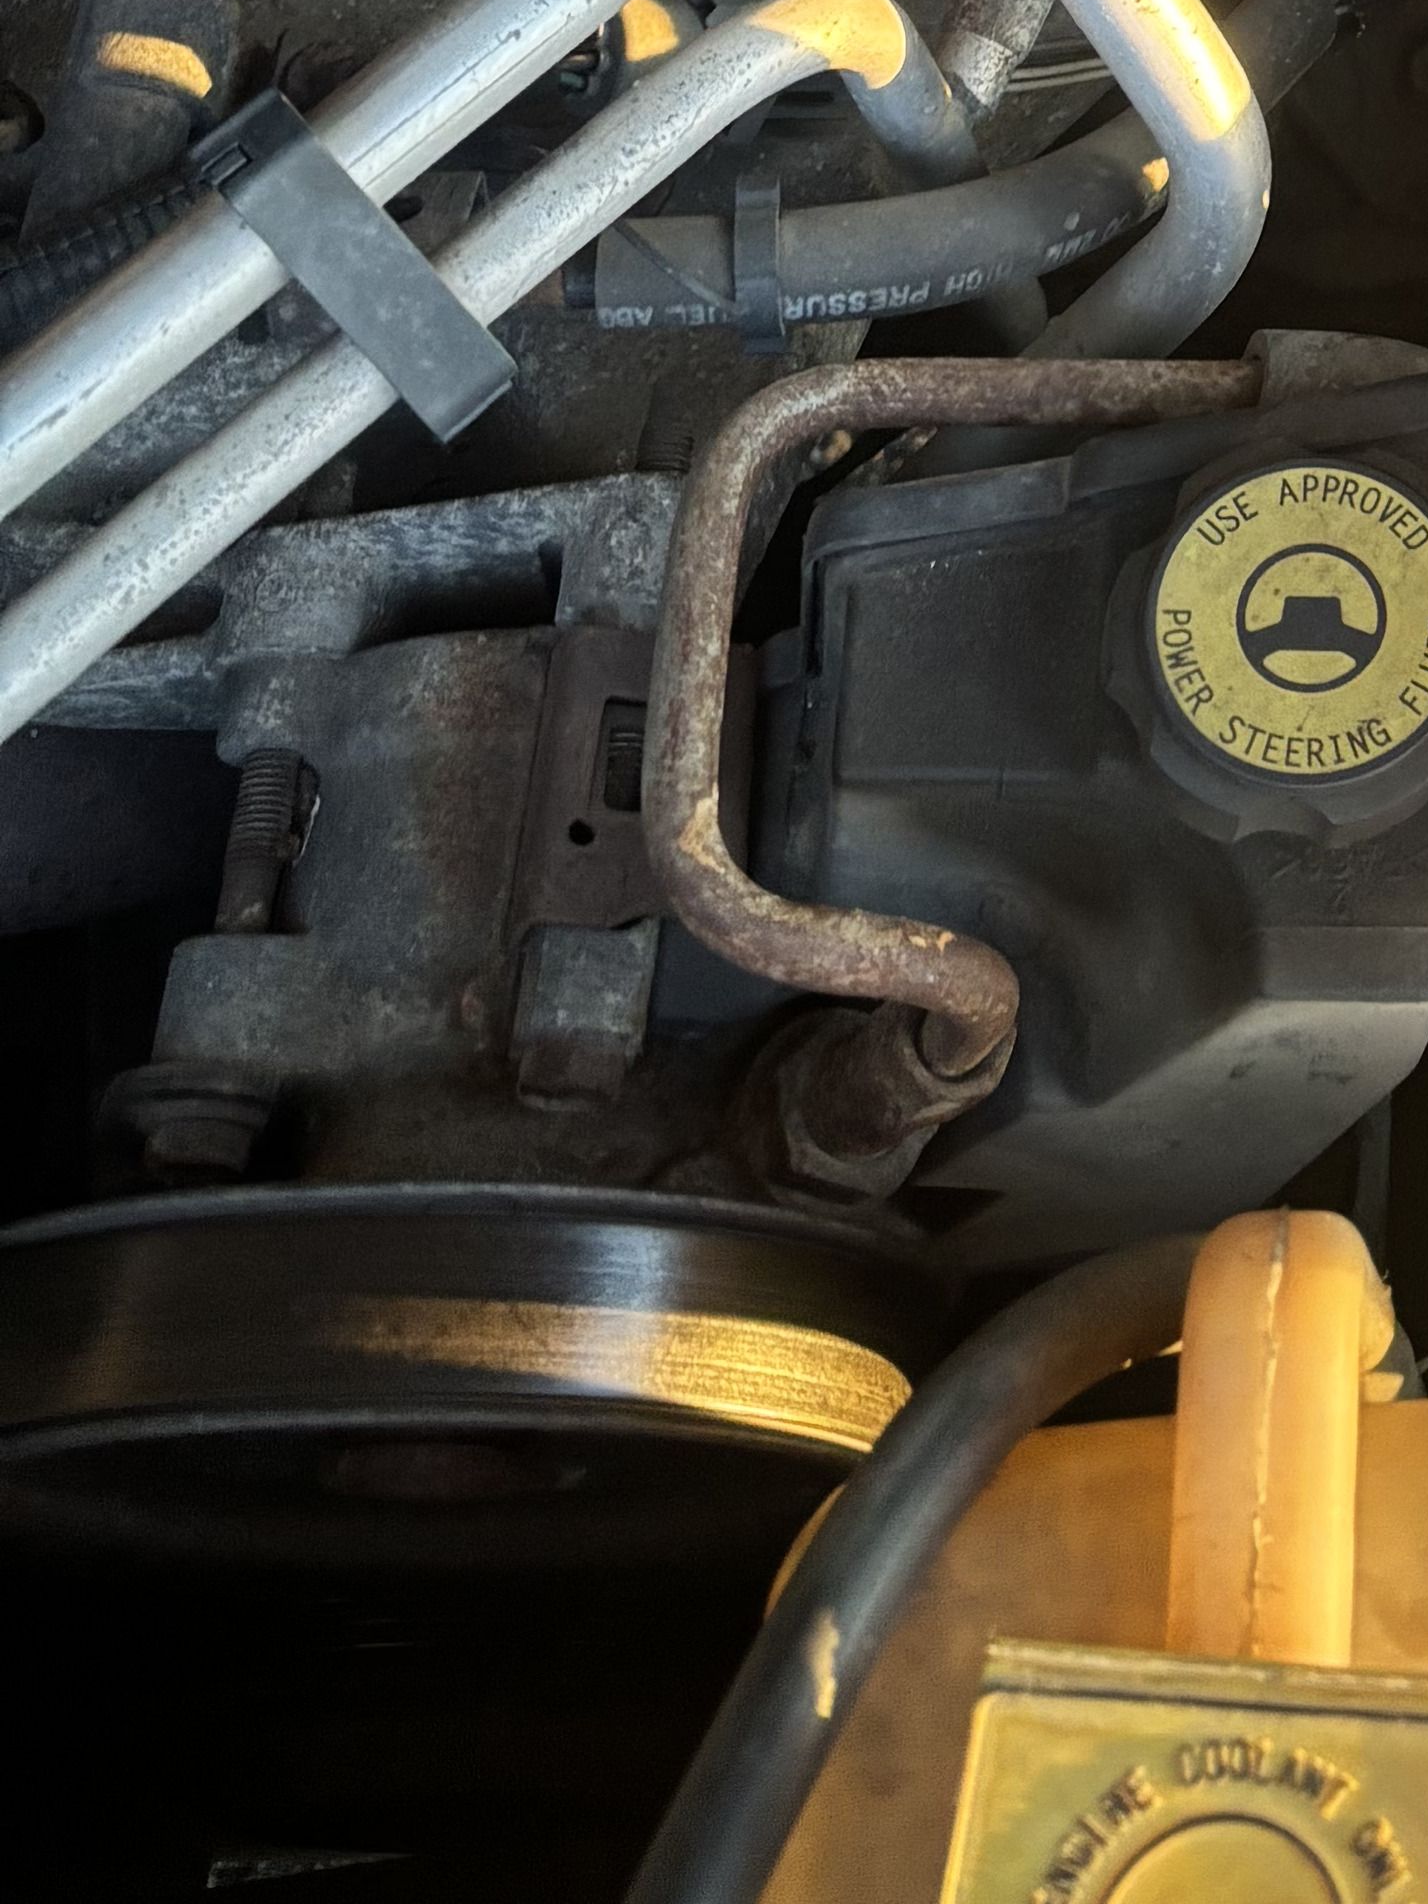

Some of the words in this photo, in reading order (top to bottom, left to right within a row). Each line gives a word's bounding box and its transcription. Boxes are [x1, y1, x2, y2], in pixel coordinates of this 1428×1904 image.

[781, 280, 931, 323] PRESSUR
[1196, 491, 1259, 547] USE
[1162, 608, 1214, 716] POWER
[1219, 714, 1392, 768] STEERING
[1172, 1736, 1360, 1822] COOLANT
